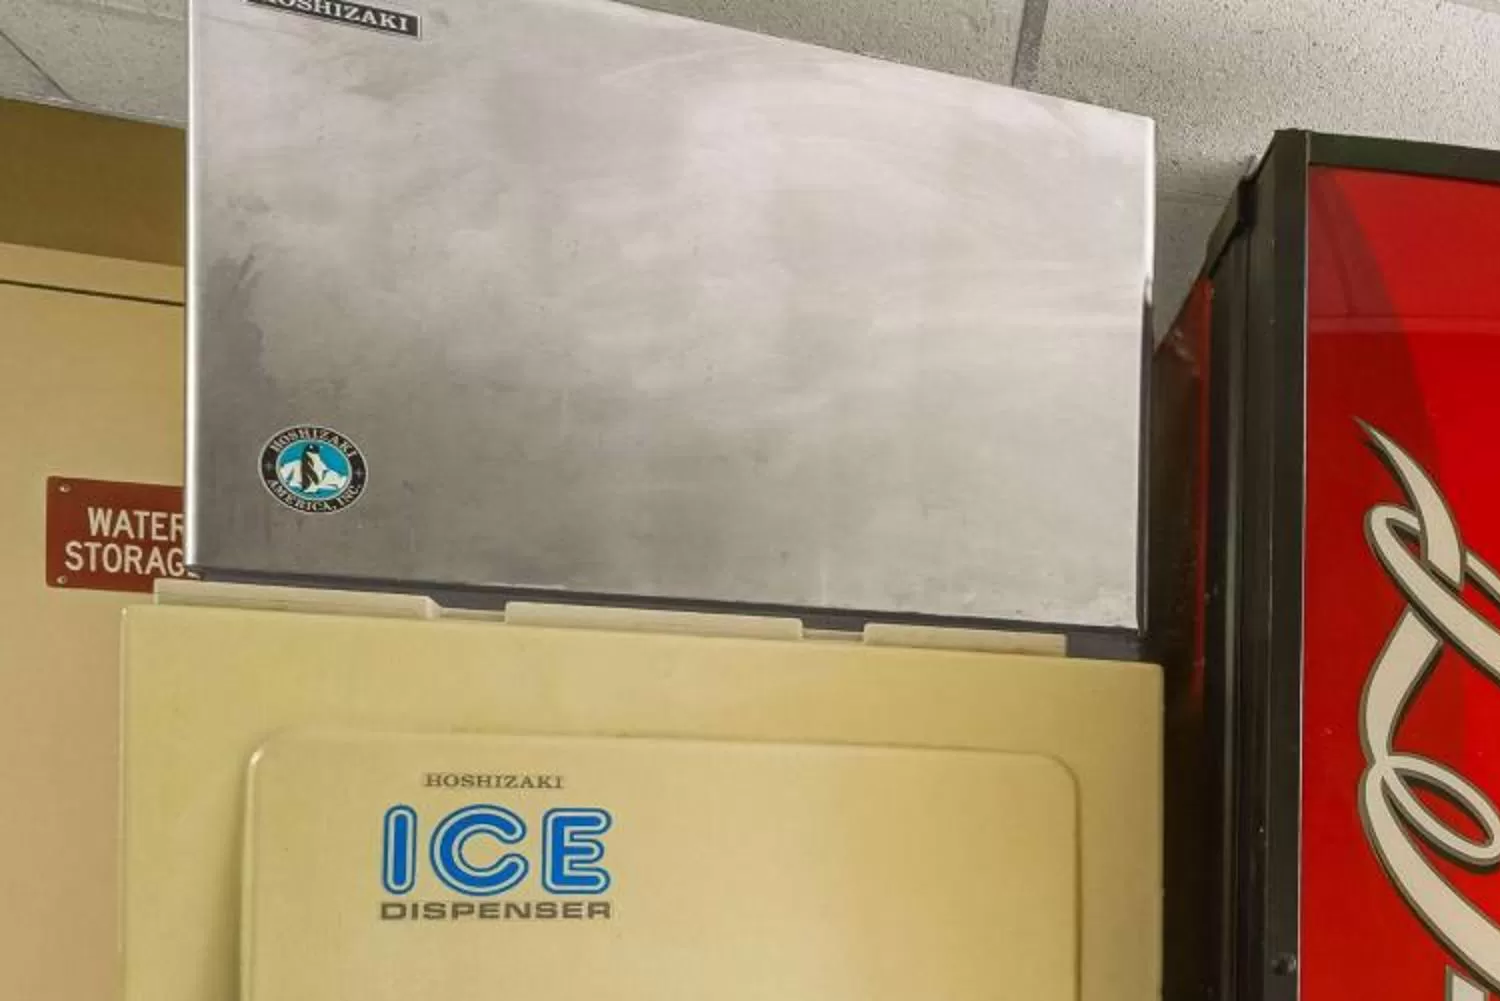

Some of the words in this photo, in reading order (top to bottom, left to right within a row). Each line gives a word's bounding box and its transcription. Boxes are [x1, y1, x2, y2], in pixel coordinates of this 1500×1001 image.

[260, 0, 409, 31] OSHIZAKI
[270, 428, 358, 458] HOSHIZAKI
[64, 540, 199, 579] STORAG
[424, 772, 566, 790] HOSHIZAKI
[382, 803, 613, 897] ICE
[380, 901, 612, 921] DISPENSER
